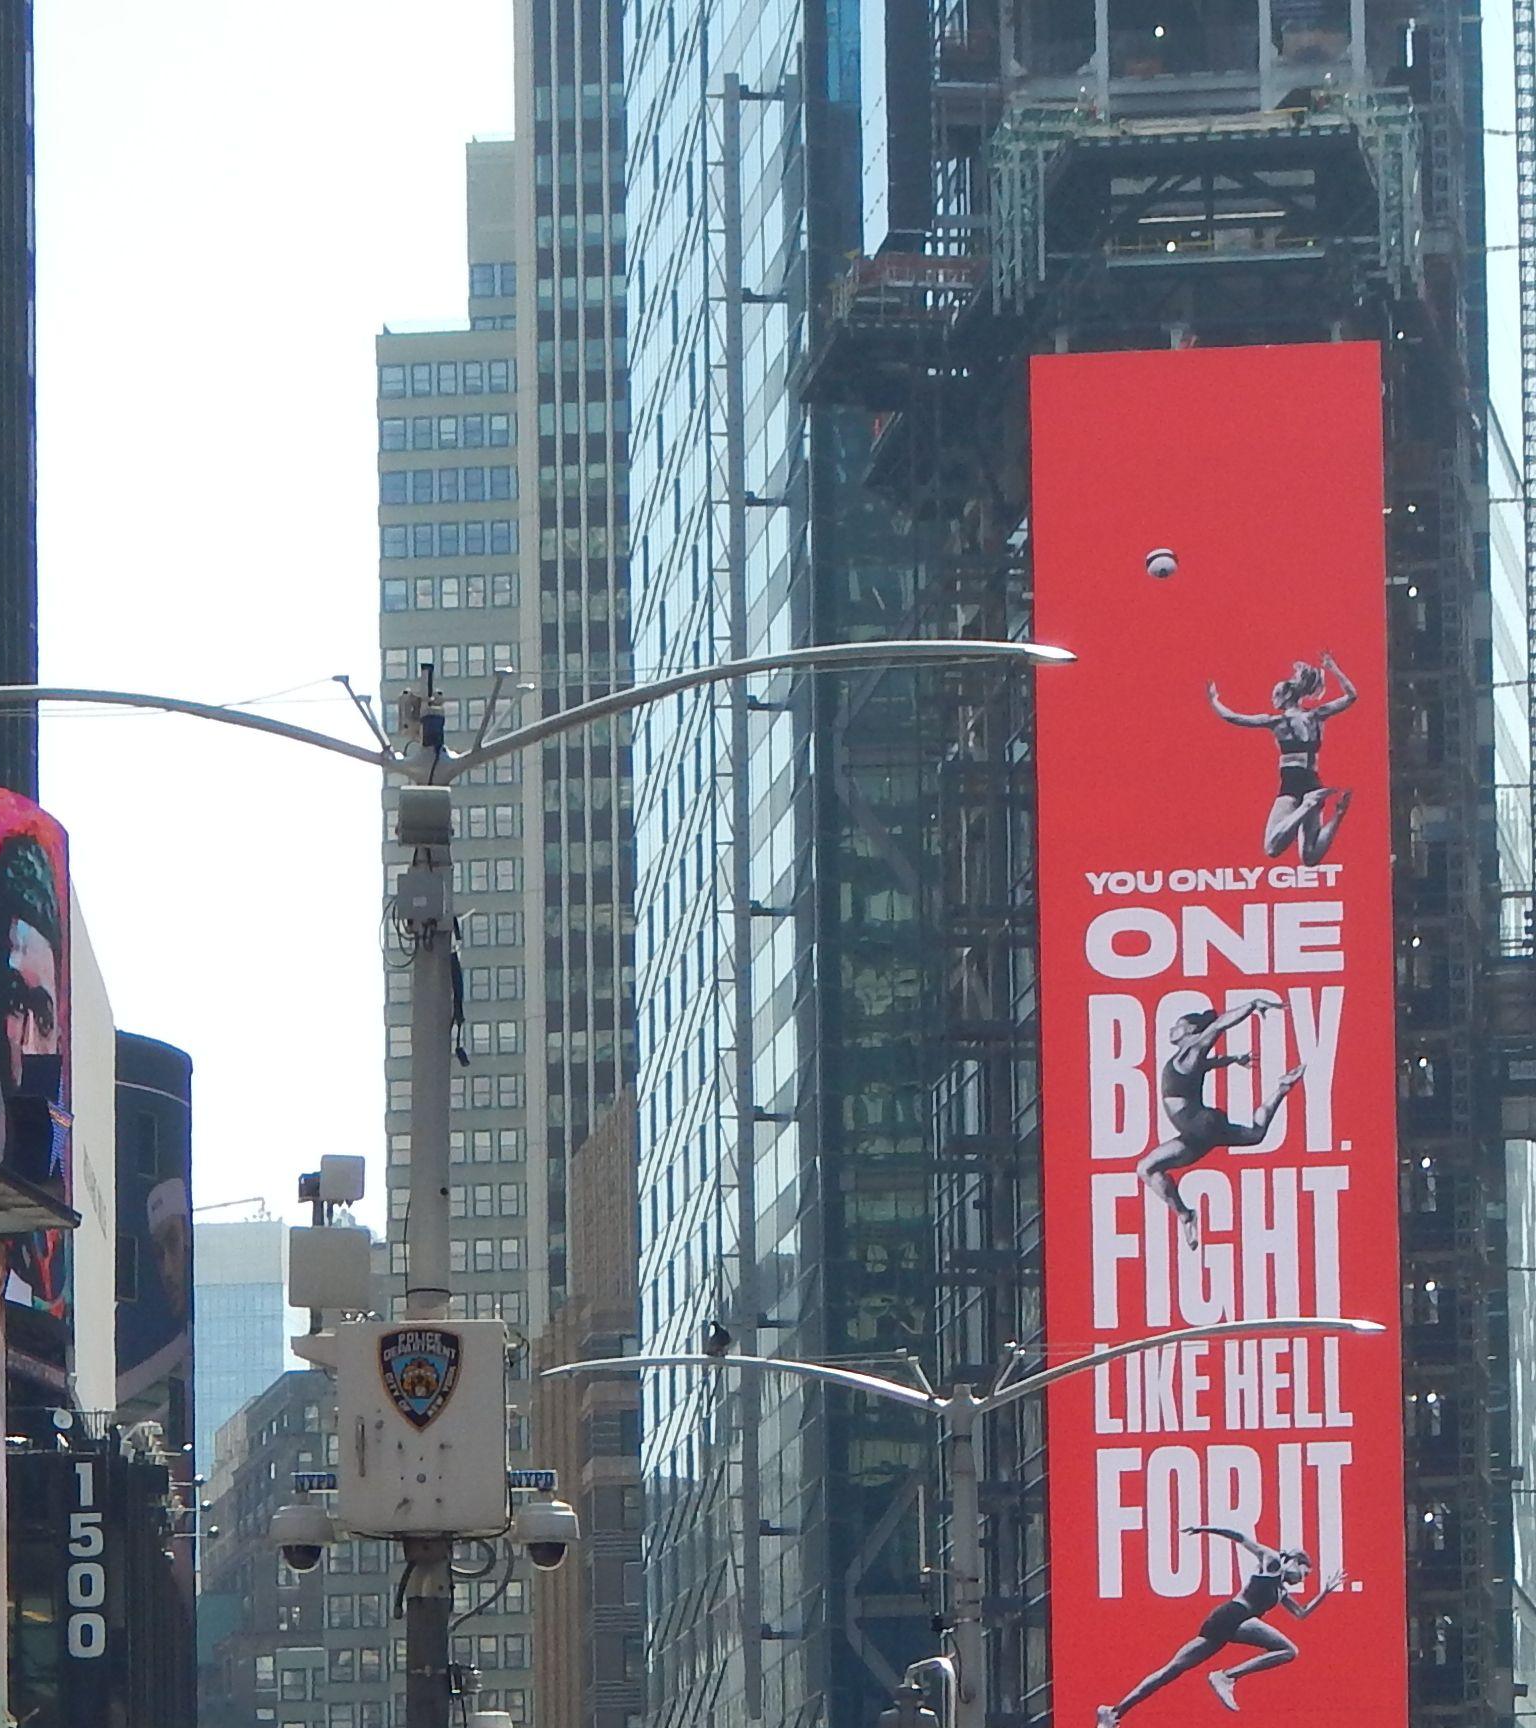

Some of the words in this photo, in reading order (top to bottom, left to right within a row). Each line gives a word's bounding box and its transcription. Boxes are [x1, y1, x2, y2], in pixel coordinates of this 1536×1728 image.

[1084, 870, 1163, 895] YOU
[1169, 866, 1264, 892] ONLY
[1267, 864, 1344, 889] GET
[1084, 901, 1345, 980] ONE
[1090, 1165, 1351, 1330] FIGHT
[383, 1342, 457, 1362] DEPARTMENT
[397, 1332, 443, 1345] POLICE
[1094, 1341, 1211, 1435] LIKE
[1224, 1336, 1354, 1431] HELL
[67, 1461, 107, 1659] 1500
[1096, 1443, 1263, 1599] FOR
